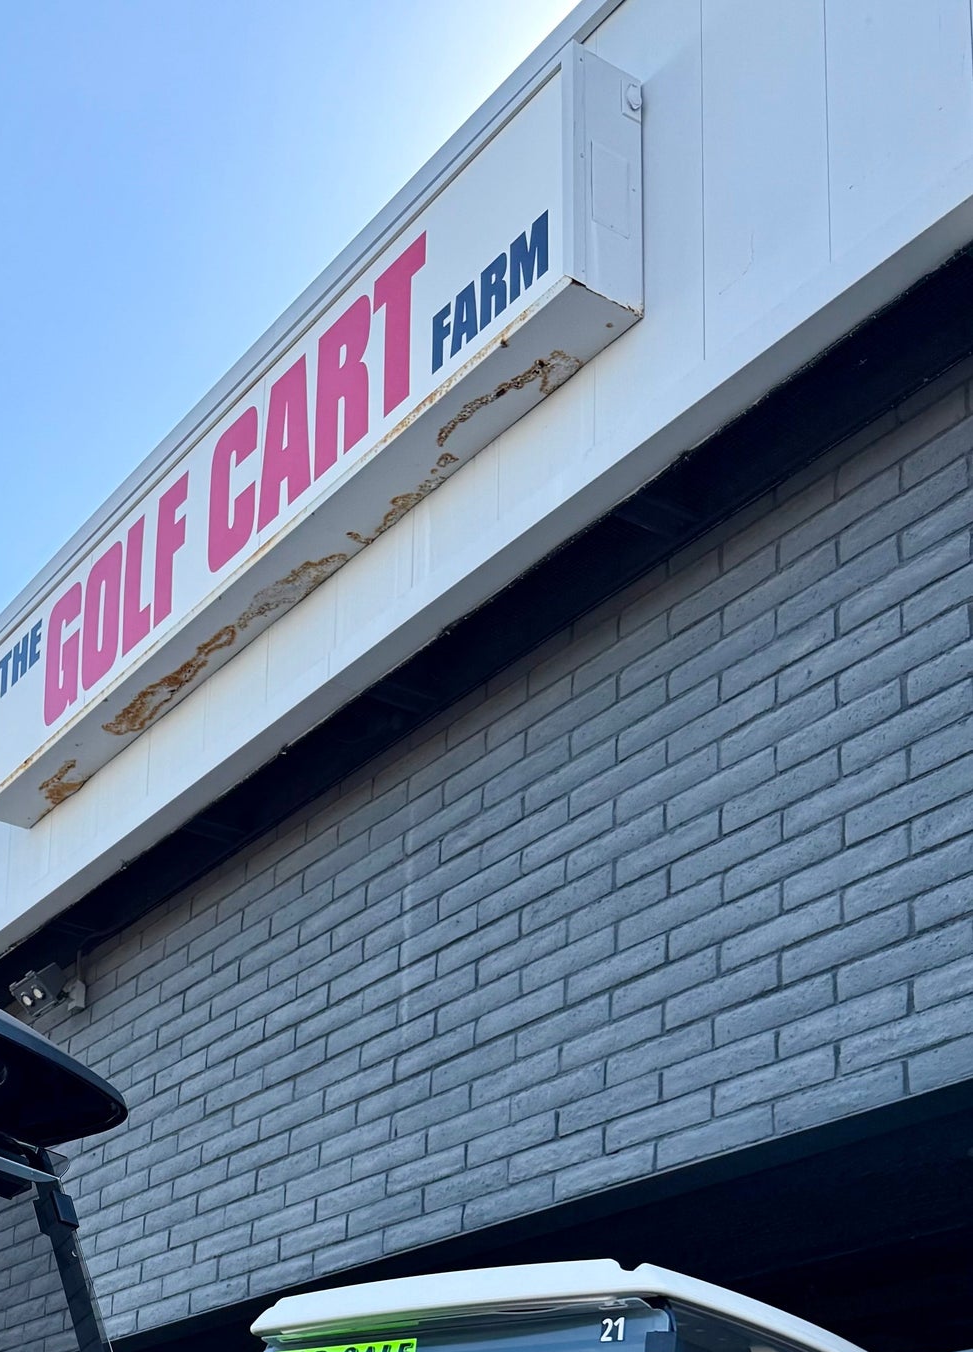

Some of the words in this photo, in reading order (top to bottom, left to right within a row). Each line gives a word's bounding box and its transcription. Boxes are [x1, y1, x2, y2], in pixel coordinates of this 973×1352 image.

[0, 618, 42, 698] THE
[44, 470, 189, 727] GOLF
[207, 231, 427, 574] CART
[431, 209, 549, 375] FARM
[600, 1316, 625, 1342] 21
